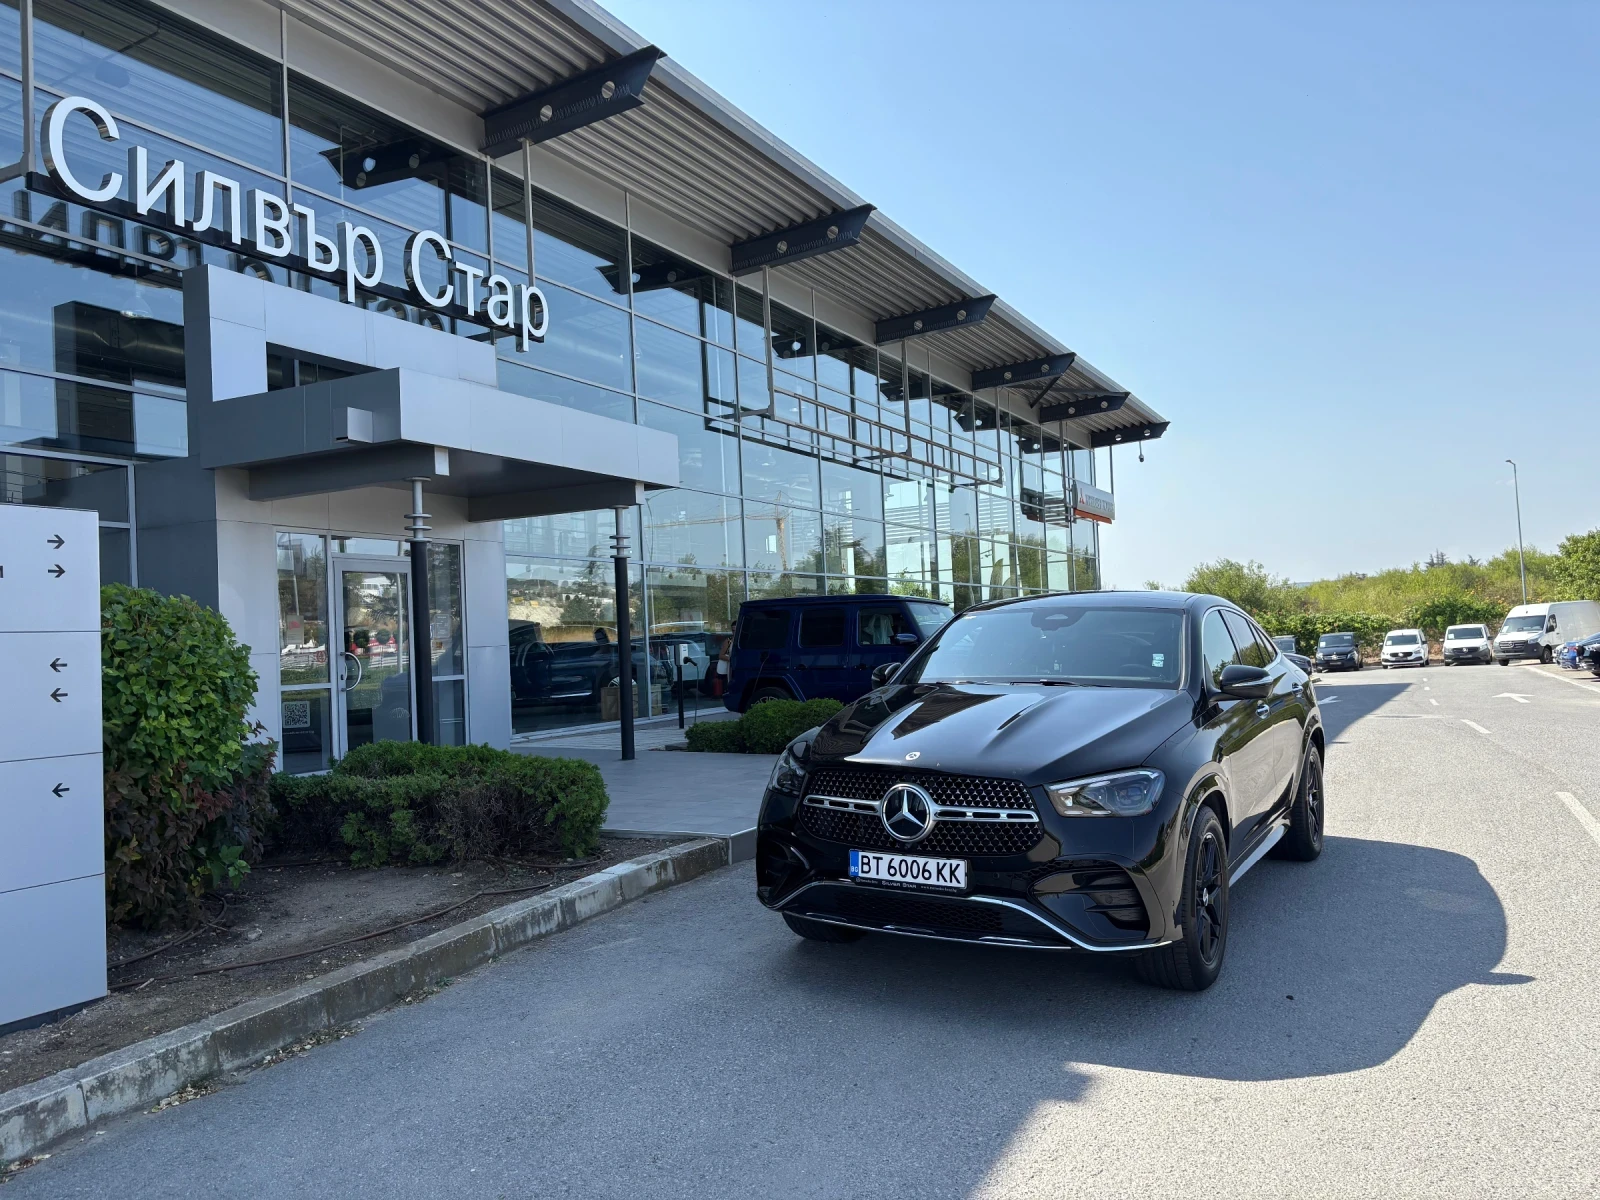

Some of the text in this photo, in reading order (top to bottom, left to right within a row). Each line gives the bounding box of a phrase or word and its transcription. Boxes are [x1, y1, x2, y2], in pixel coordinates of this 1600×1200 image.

[42, 96, 384, 303] Силвър
[404, 229, 549, 352] Стар
[860, 855, 961, 884] BT 6006 KK
